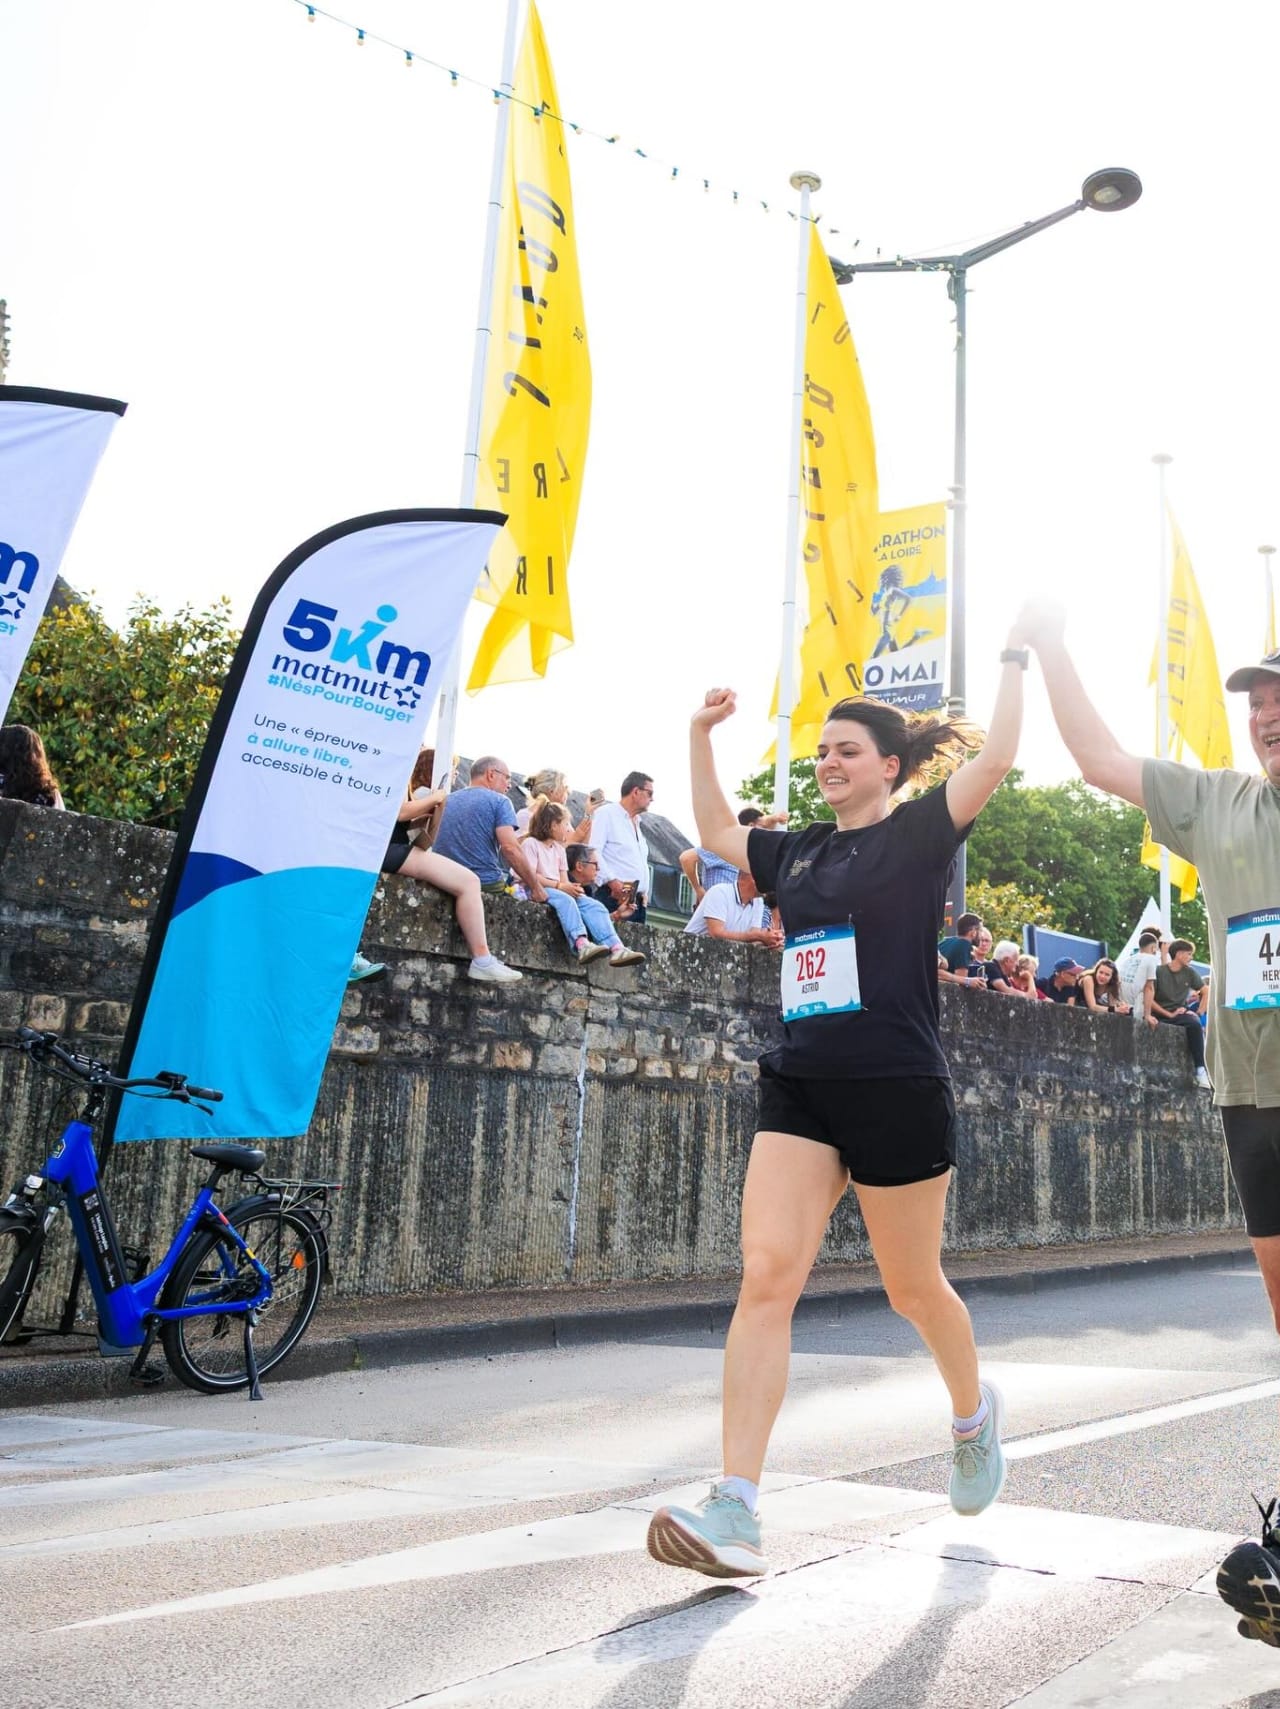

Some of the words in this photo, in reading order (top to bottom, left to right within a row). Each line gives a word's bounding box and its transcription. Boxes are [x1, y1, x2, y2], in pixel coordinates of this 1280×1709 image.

[873, 524, 945, 553] RATHON
[890, 545, 922, 560] LOIRE
[272, 654, 392, 700] matmut
[890, 661, 937, 684] MAI
[267, 672, 414, 722] #NésPourBouger
[247, 732, 259, 744] à
[262, 737, 309, 757] allure
[254, 713, 287, 733] Une
[304, 727, 369, 753] épreuve
[241, 752, 328, 781] accessible
[331, 772, 343, 784] à
[347, 775, 382, 796] tous
[796, 947, 826, 982] 262
